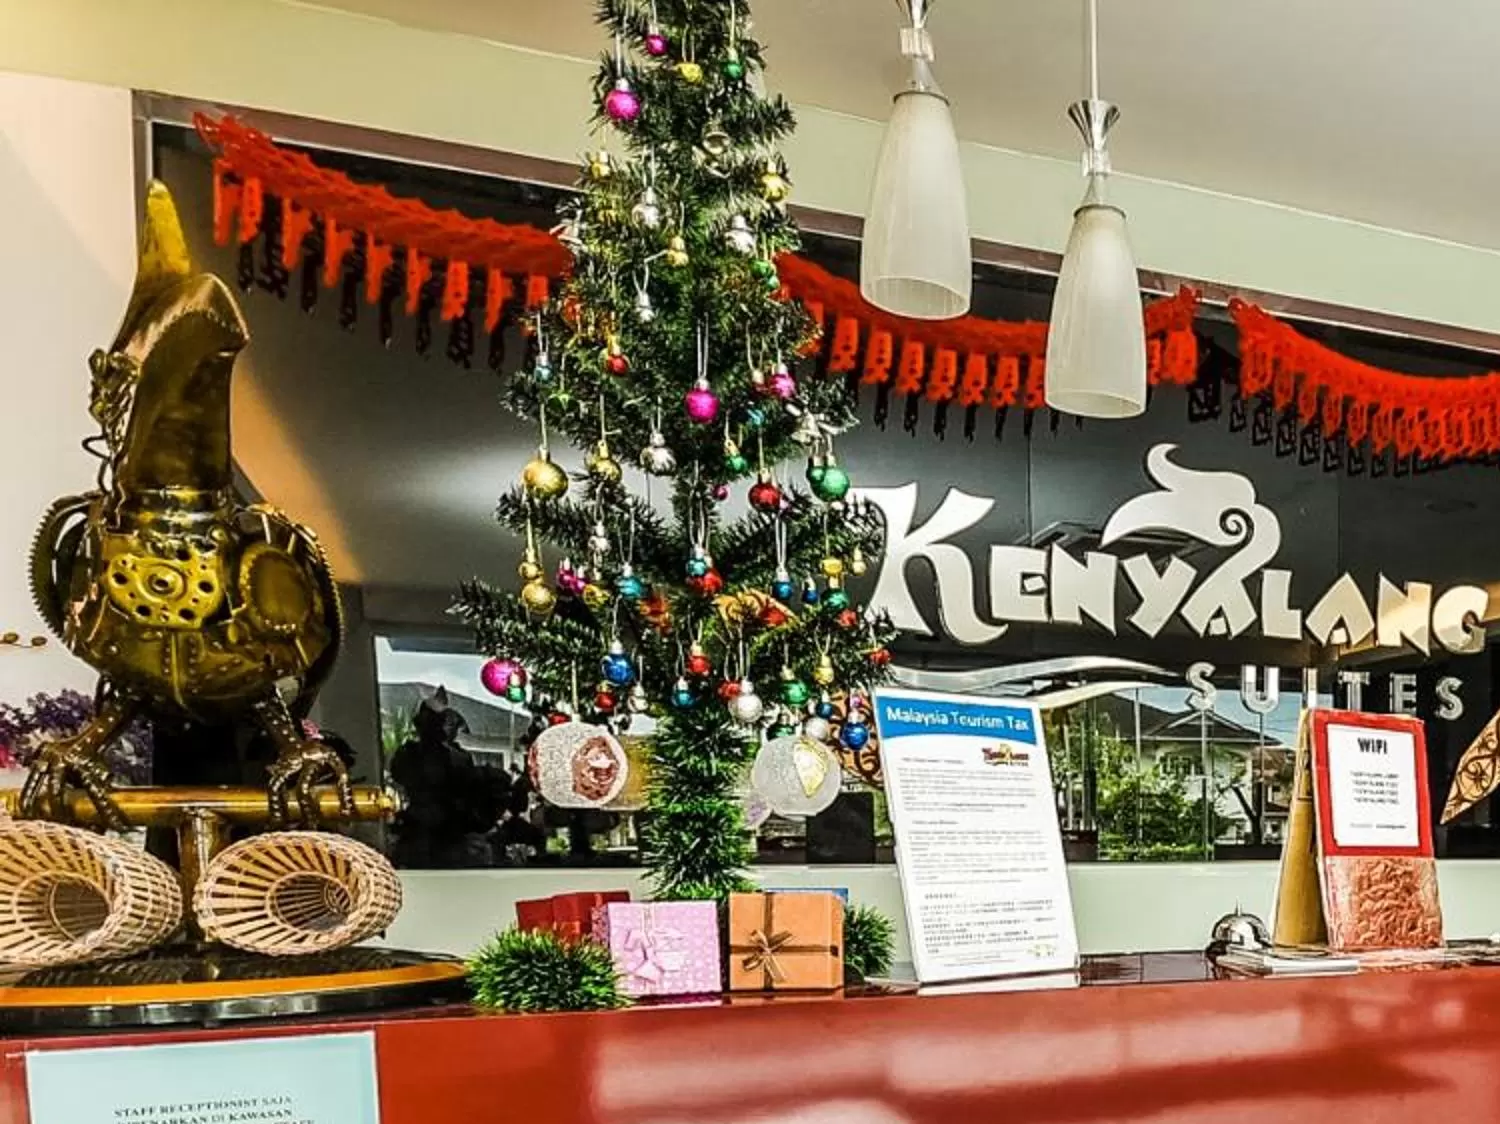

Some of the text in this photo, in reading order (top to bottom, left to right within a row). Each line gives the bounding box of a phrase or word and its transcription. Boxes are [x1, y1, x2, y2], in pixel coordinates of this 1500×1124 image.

[846, 443, 1489, 657] KENYALANG
[1186, 661, 1464, 720] SUITES
[886, 706, 1030, 731] Malaysia Tourism Tax
[114, 1105, 154, 1117] STAFF
[159, 1099, 257, 1115] RECEPTIONIST
[229, 1108, 293, 1121] KAWASAN
